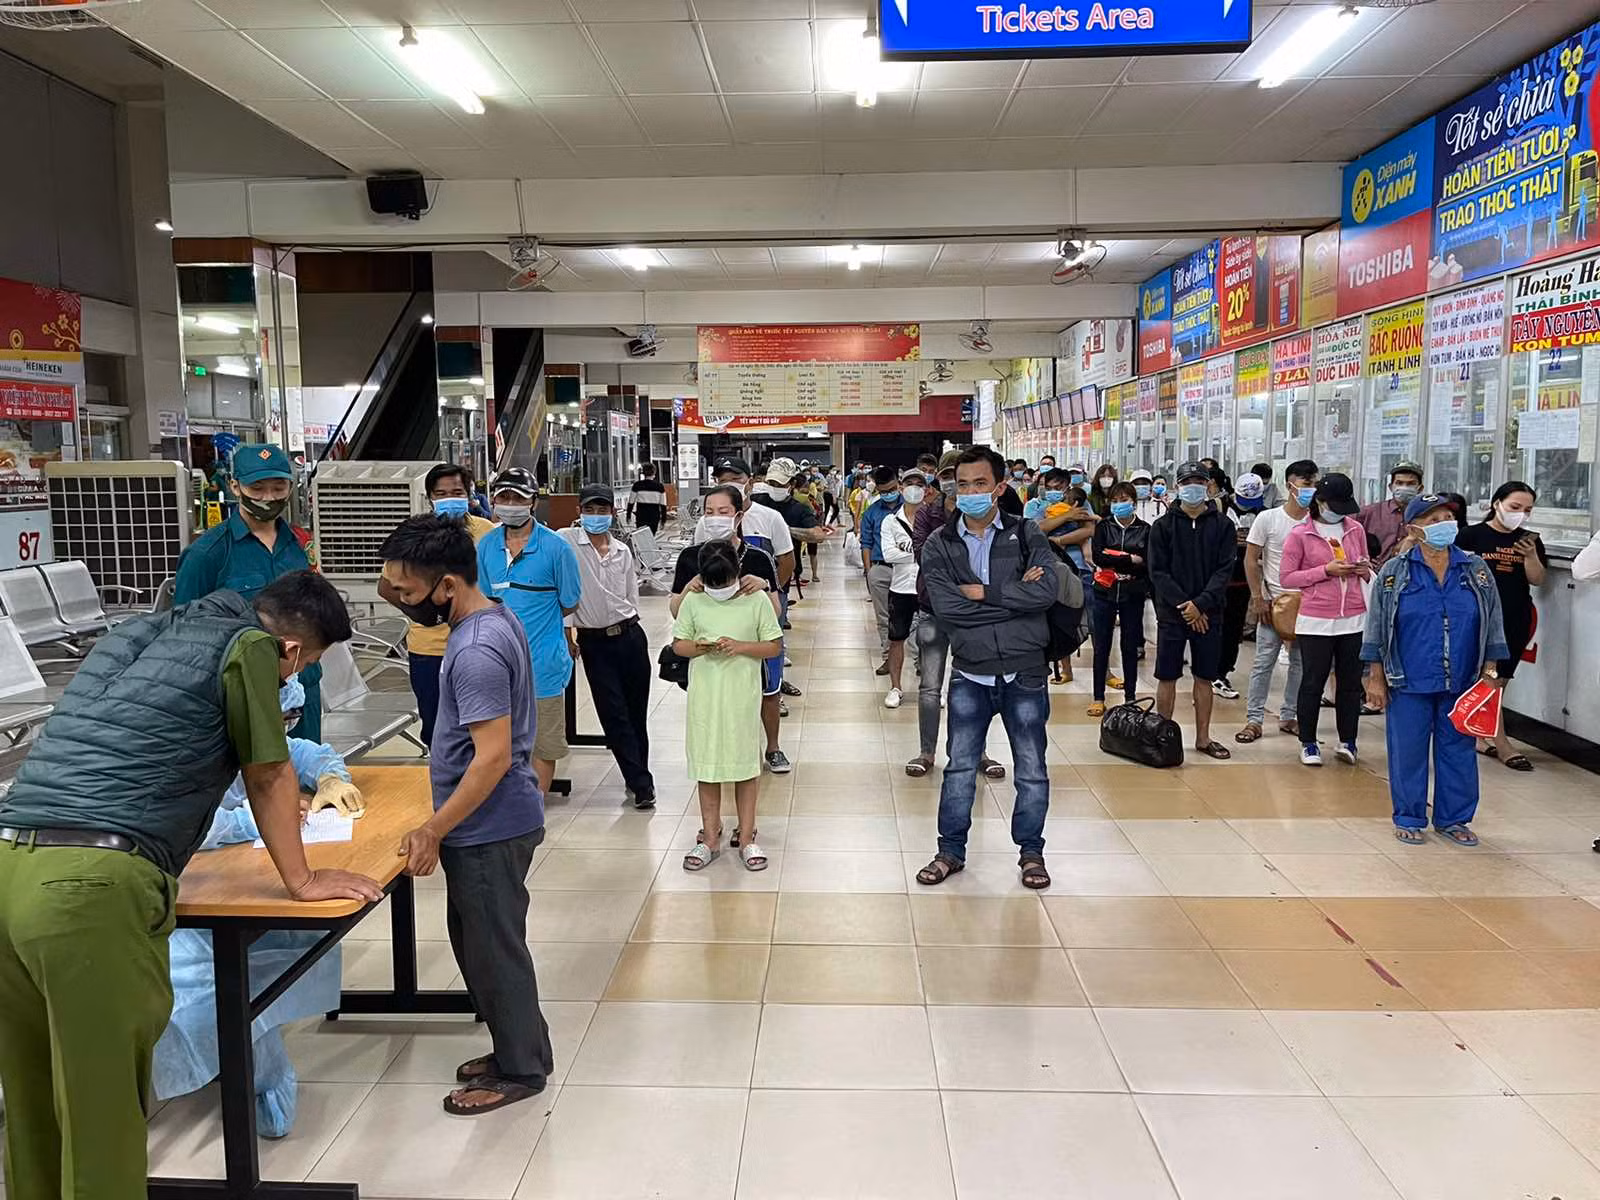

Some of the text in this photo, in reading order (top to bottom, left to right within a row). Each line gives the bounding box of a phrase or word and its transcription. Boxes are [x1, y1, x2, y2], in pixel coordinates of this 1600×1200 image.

[976, 4, 1154, 33] Tickets Area
[1445, 106, 1478, 155] Tết
[1506, 75, 1557, 128] chia
[1377, 161, 1396, 183] Điện
[1443, 126, 1559, 198] HOÀN TIỀN TƯƠI
[1373, 170, 1417, 212] XANH
[1440, 166, 1561, 235] TRAO THÓC THẬT
[1348, 244, 1414, 289] TOSHIBA
[1516, 268, 1575, 298] Hoàng
[1227, 281, 1250, 321] 20%
[1515, 287, 1600, 314] THÁI BÌNH
[1318, 331, 1339, 345] HÒA
[1512, 331, 1600, 353] KON TUM
[1513, 313, 1542, 342] TÂY
[1143, 337, 1166, 359] TOSHIBA
[1548, 348, 1562, 371] 22
[26, 361, 63, 374] HEINEKEN
[1390, 373, 1400, 390] 20
[1460, 362, 1470, 381] 21
[18, 531, 41, 561] 87
